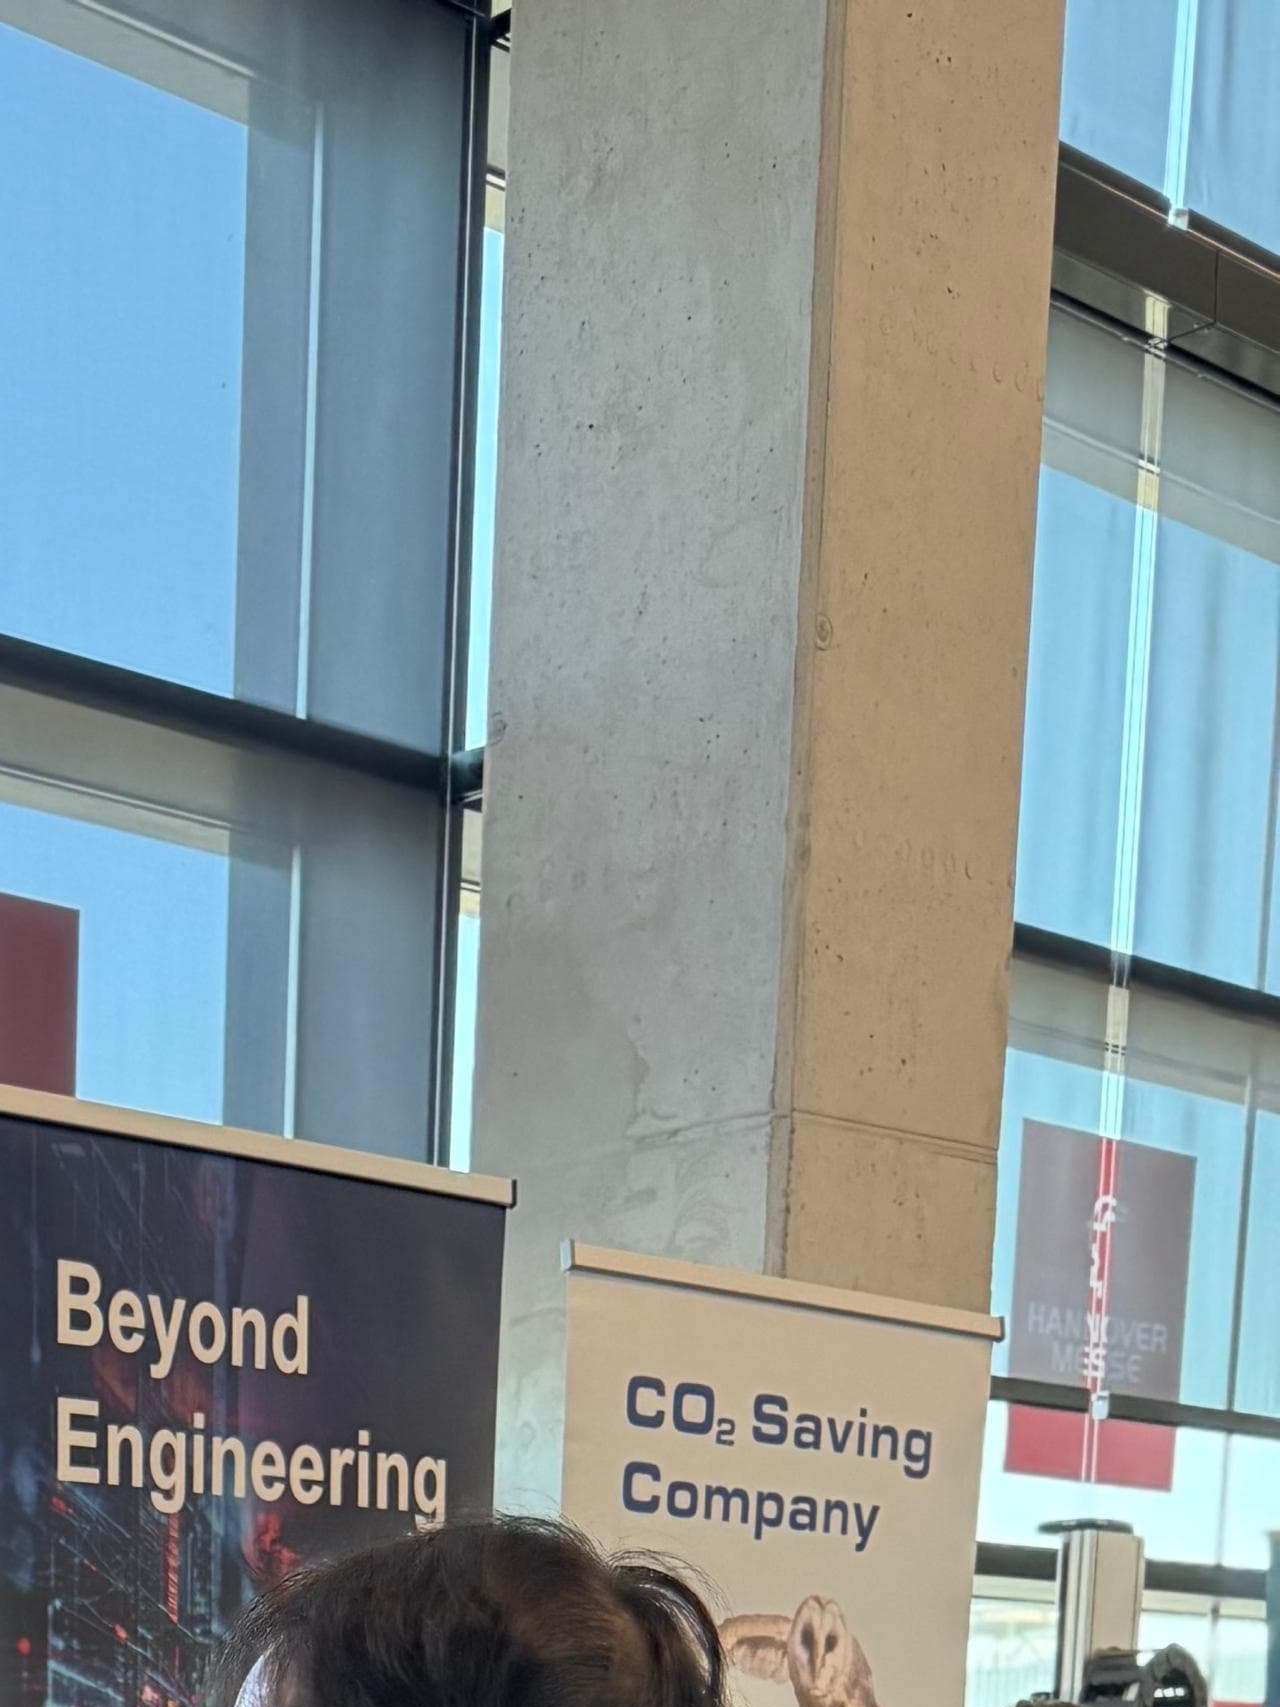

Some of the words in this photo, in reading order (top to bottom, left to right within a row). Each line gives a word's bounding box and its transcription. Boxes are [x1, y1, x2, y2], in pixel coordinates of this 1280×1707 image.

[56, 1258, 309, 1380] Beyond
[56, 1396, 447, 1533] Engineering
[751, 1393, 933, 1479] Saving
[622, 1460, 880, 1552] Company
